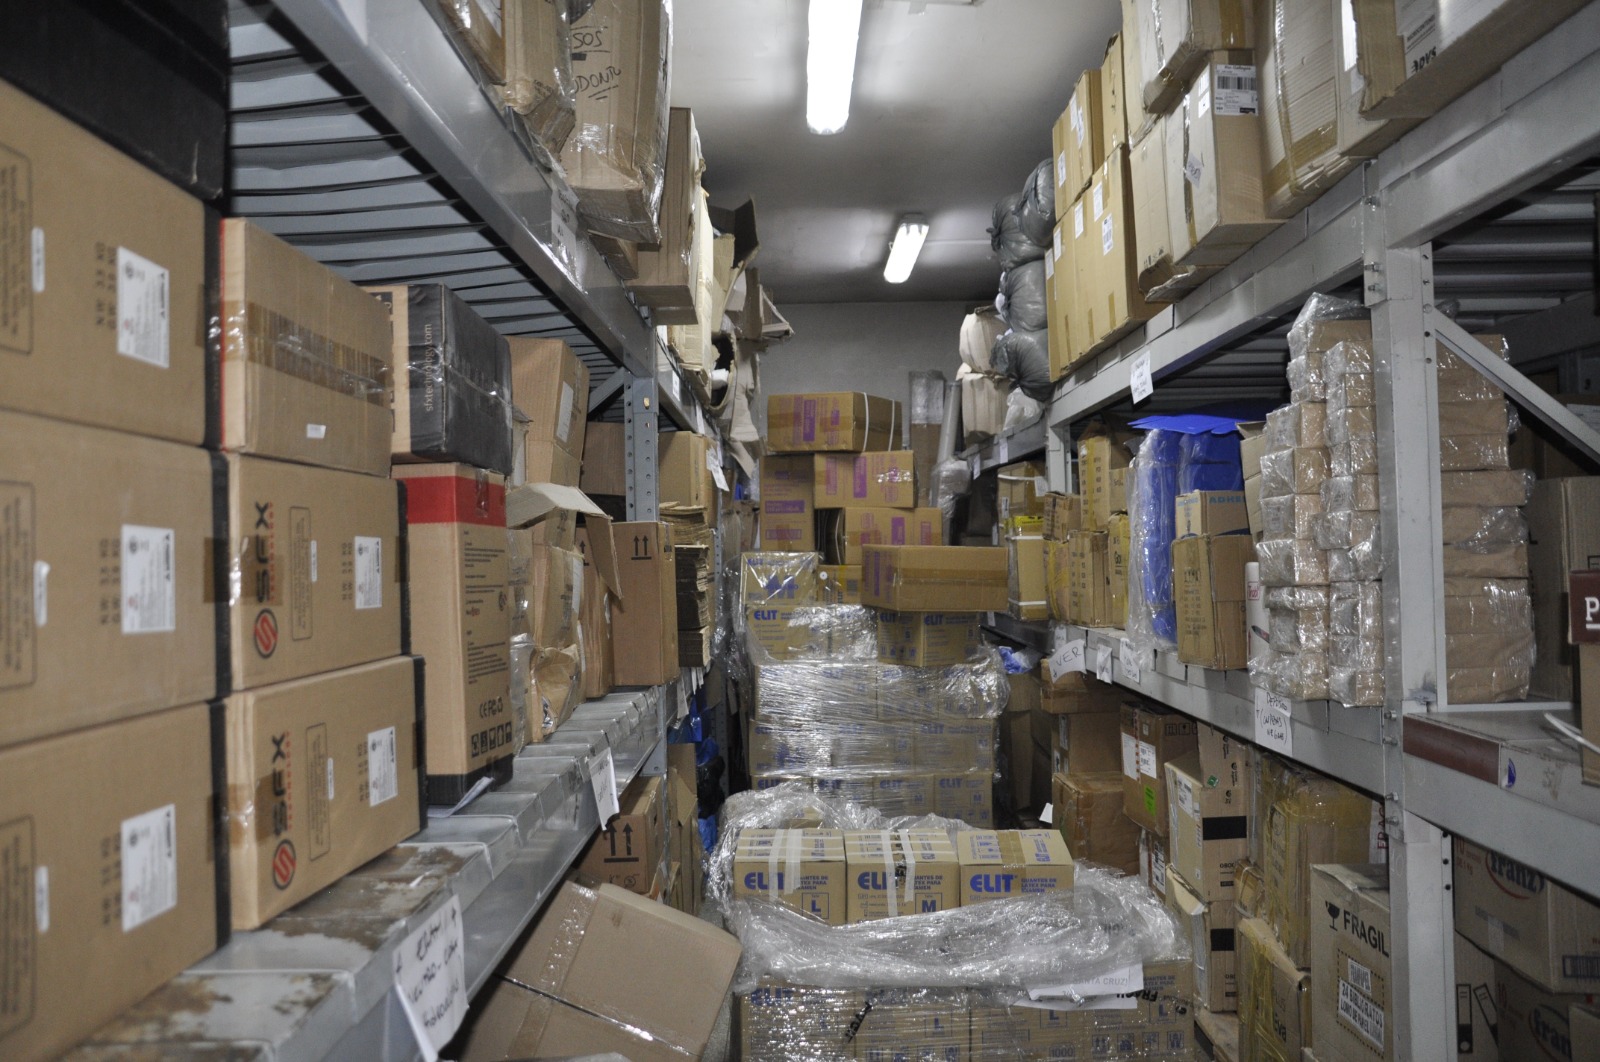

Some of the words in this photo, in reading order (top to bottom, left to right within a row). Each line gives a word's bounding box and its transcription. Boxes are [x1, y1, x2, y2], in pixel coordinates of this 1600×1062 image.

[572, 30, 602, 49] SOS
[753, 609, 778, 621] ELIT
[924, 613, 944, 625] ELIT
[1056, 646, 1082, 666] VER
[938, 778, 962, 788] ELIT
[969, 873, 1015, 893] ELIT
[811, 899, 821, 912] L
[921, 899, 937, 912] M
[1343, 909, 1389, 958] FRAGIL
[1534, 1007, 1573, 1060] fran
[1050, 1046, 1074, 1057] 1000
